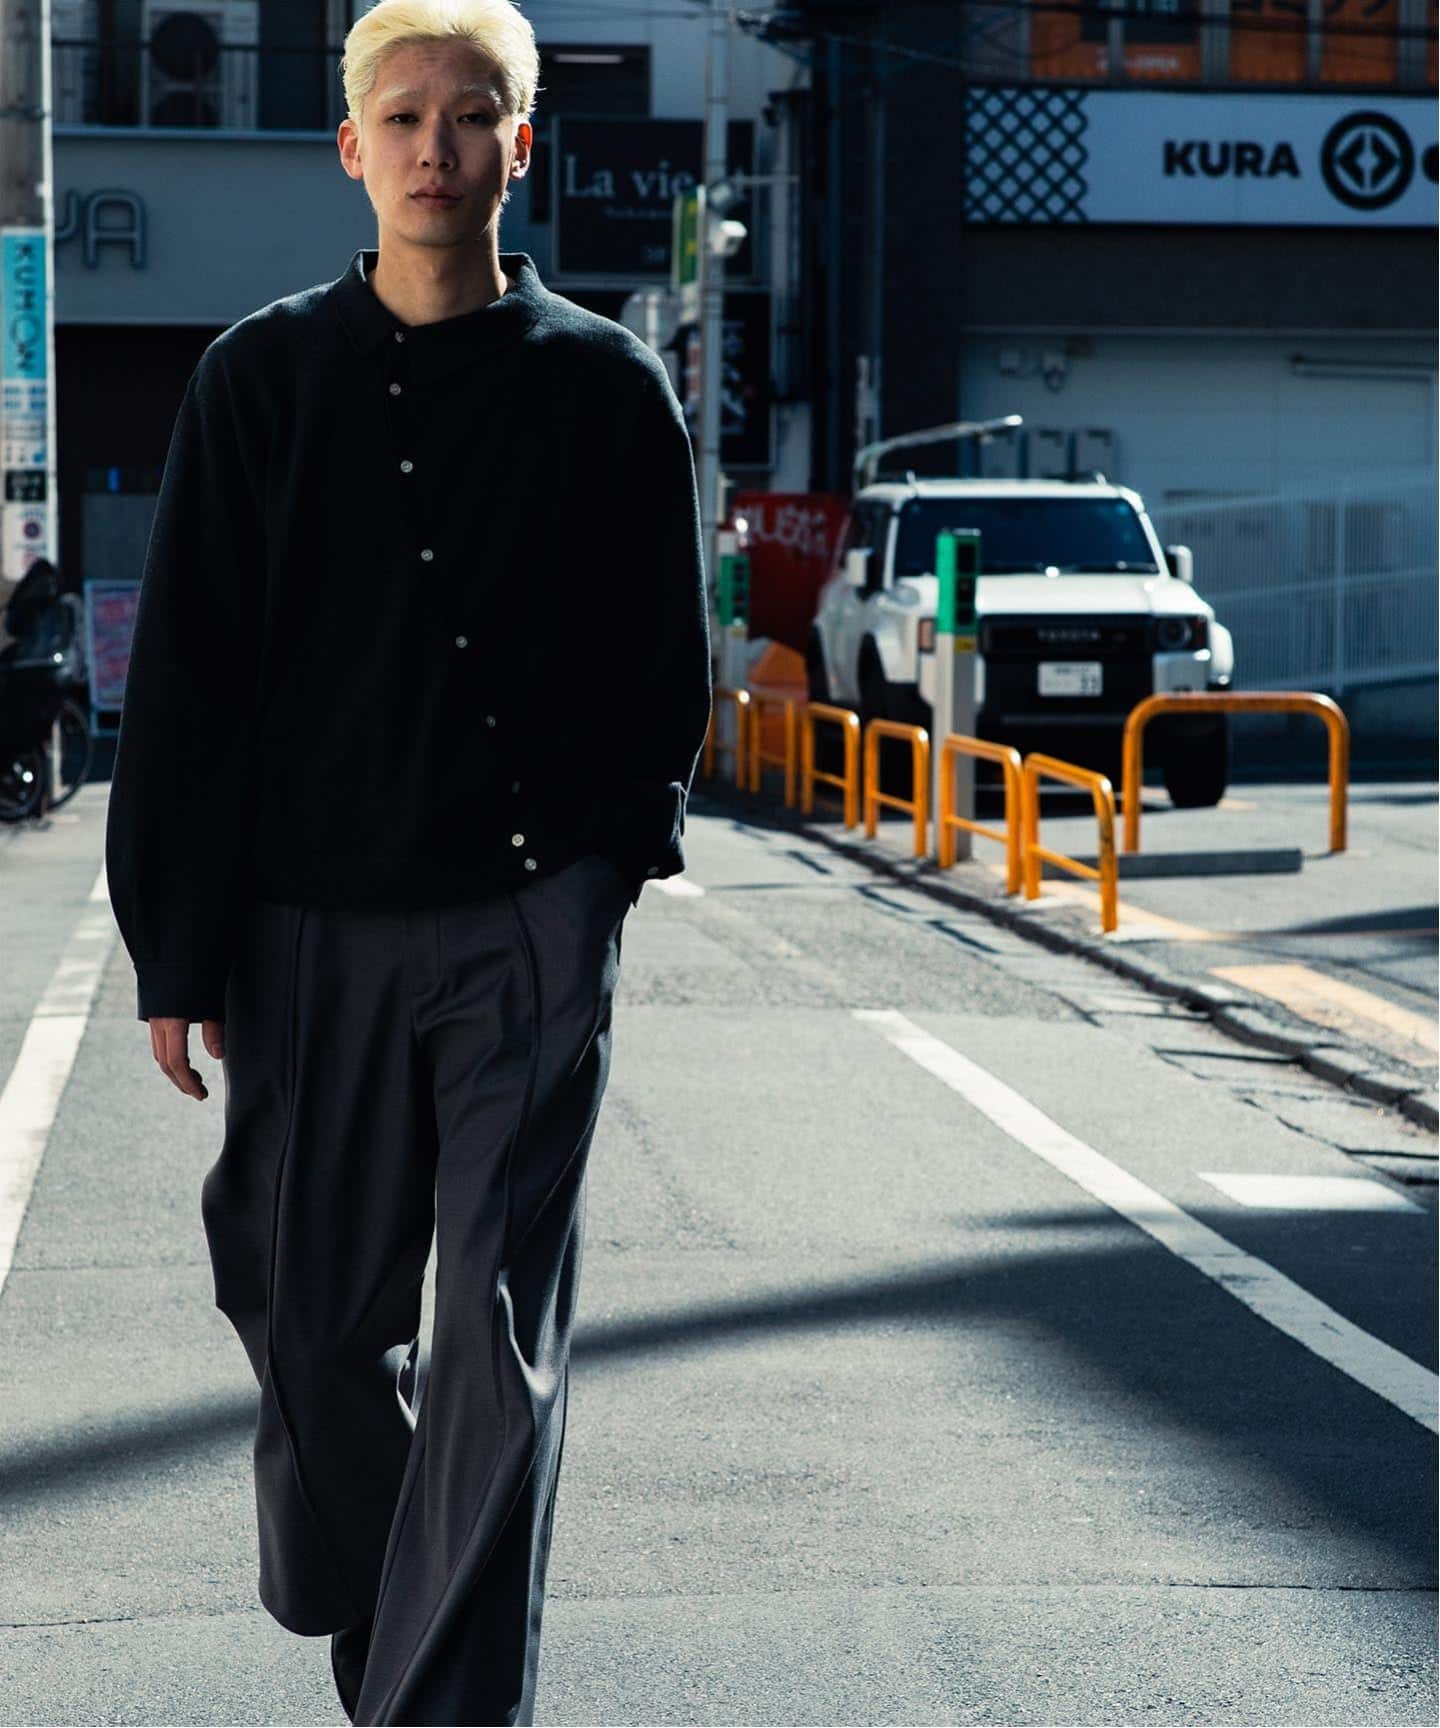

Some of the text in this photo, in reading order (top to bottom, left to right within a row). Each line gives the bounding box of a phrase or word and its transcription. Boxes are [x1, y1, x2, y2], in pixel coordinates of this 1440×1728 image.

[564, 154, 614, 197] La
[1163, 140, 1300, 178] KURA
[11, 242, 40, 371] KUMON
